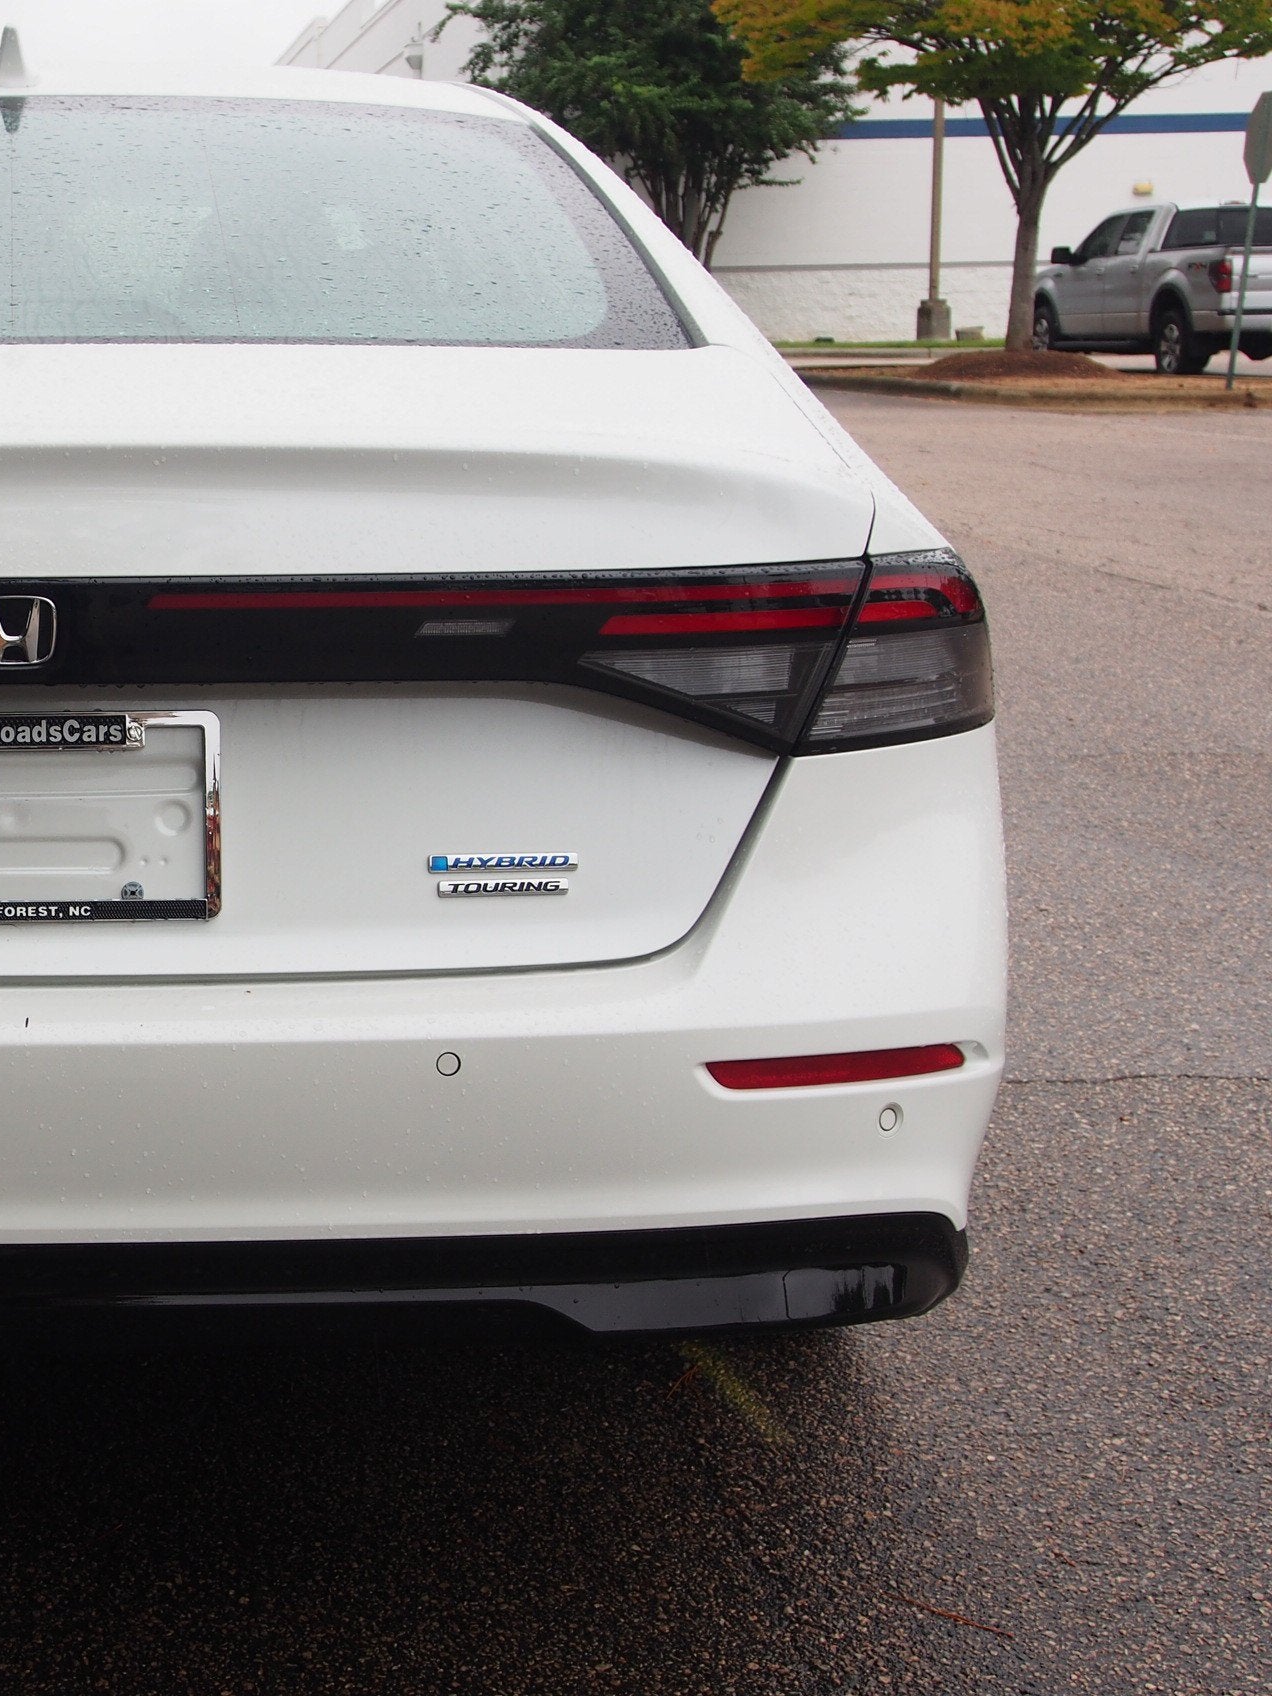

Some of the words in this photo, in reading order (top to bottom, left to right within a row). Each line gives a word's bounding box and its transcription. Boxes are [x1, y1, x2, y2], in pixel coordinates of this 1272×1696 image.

[451, 855, 571, 869] HYBRID
[447, 880, 561, 894] TOURING
[69, 905, 92, 917] NC
